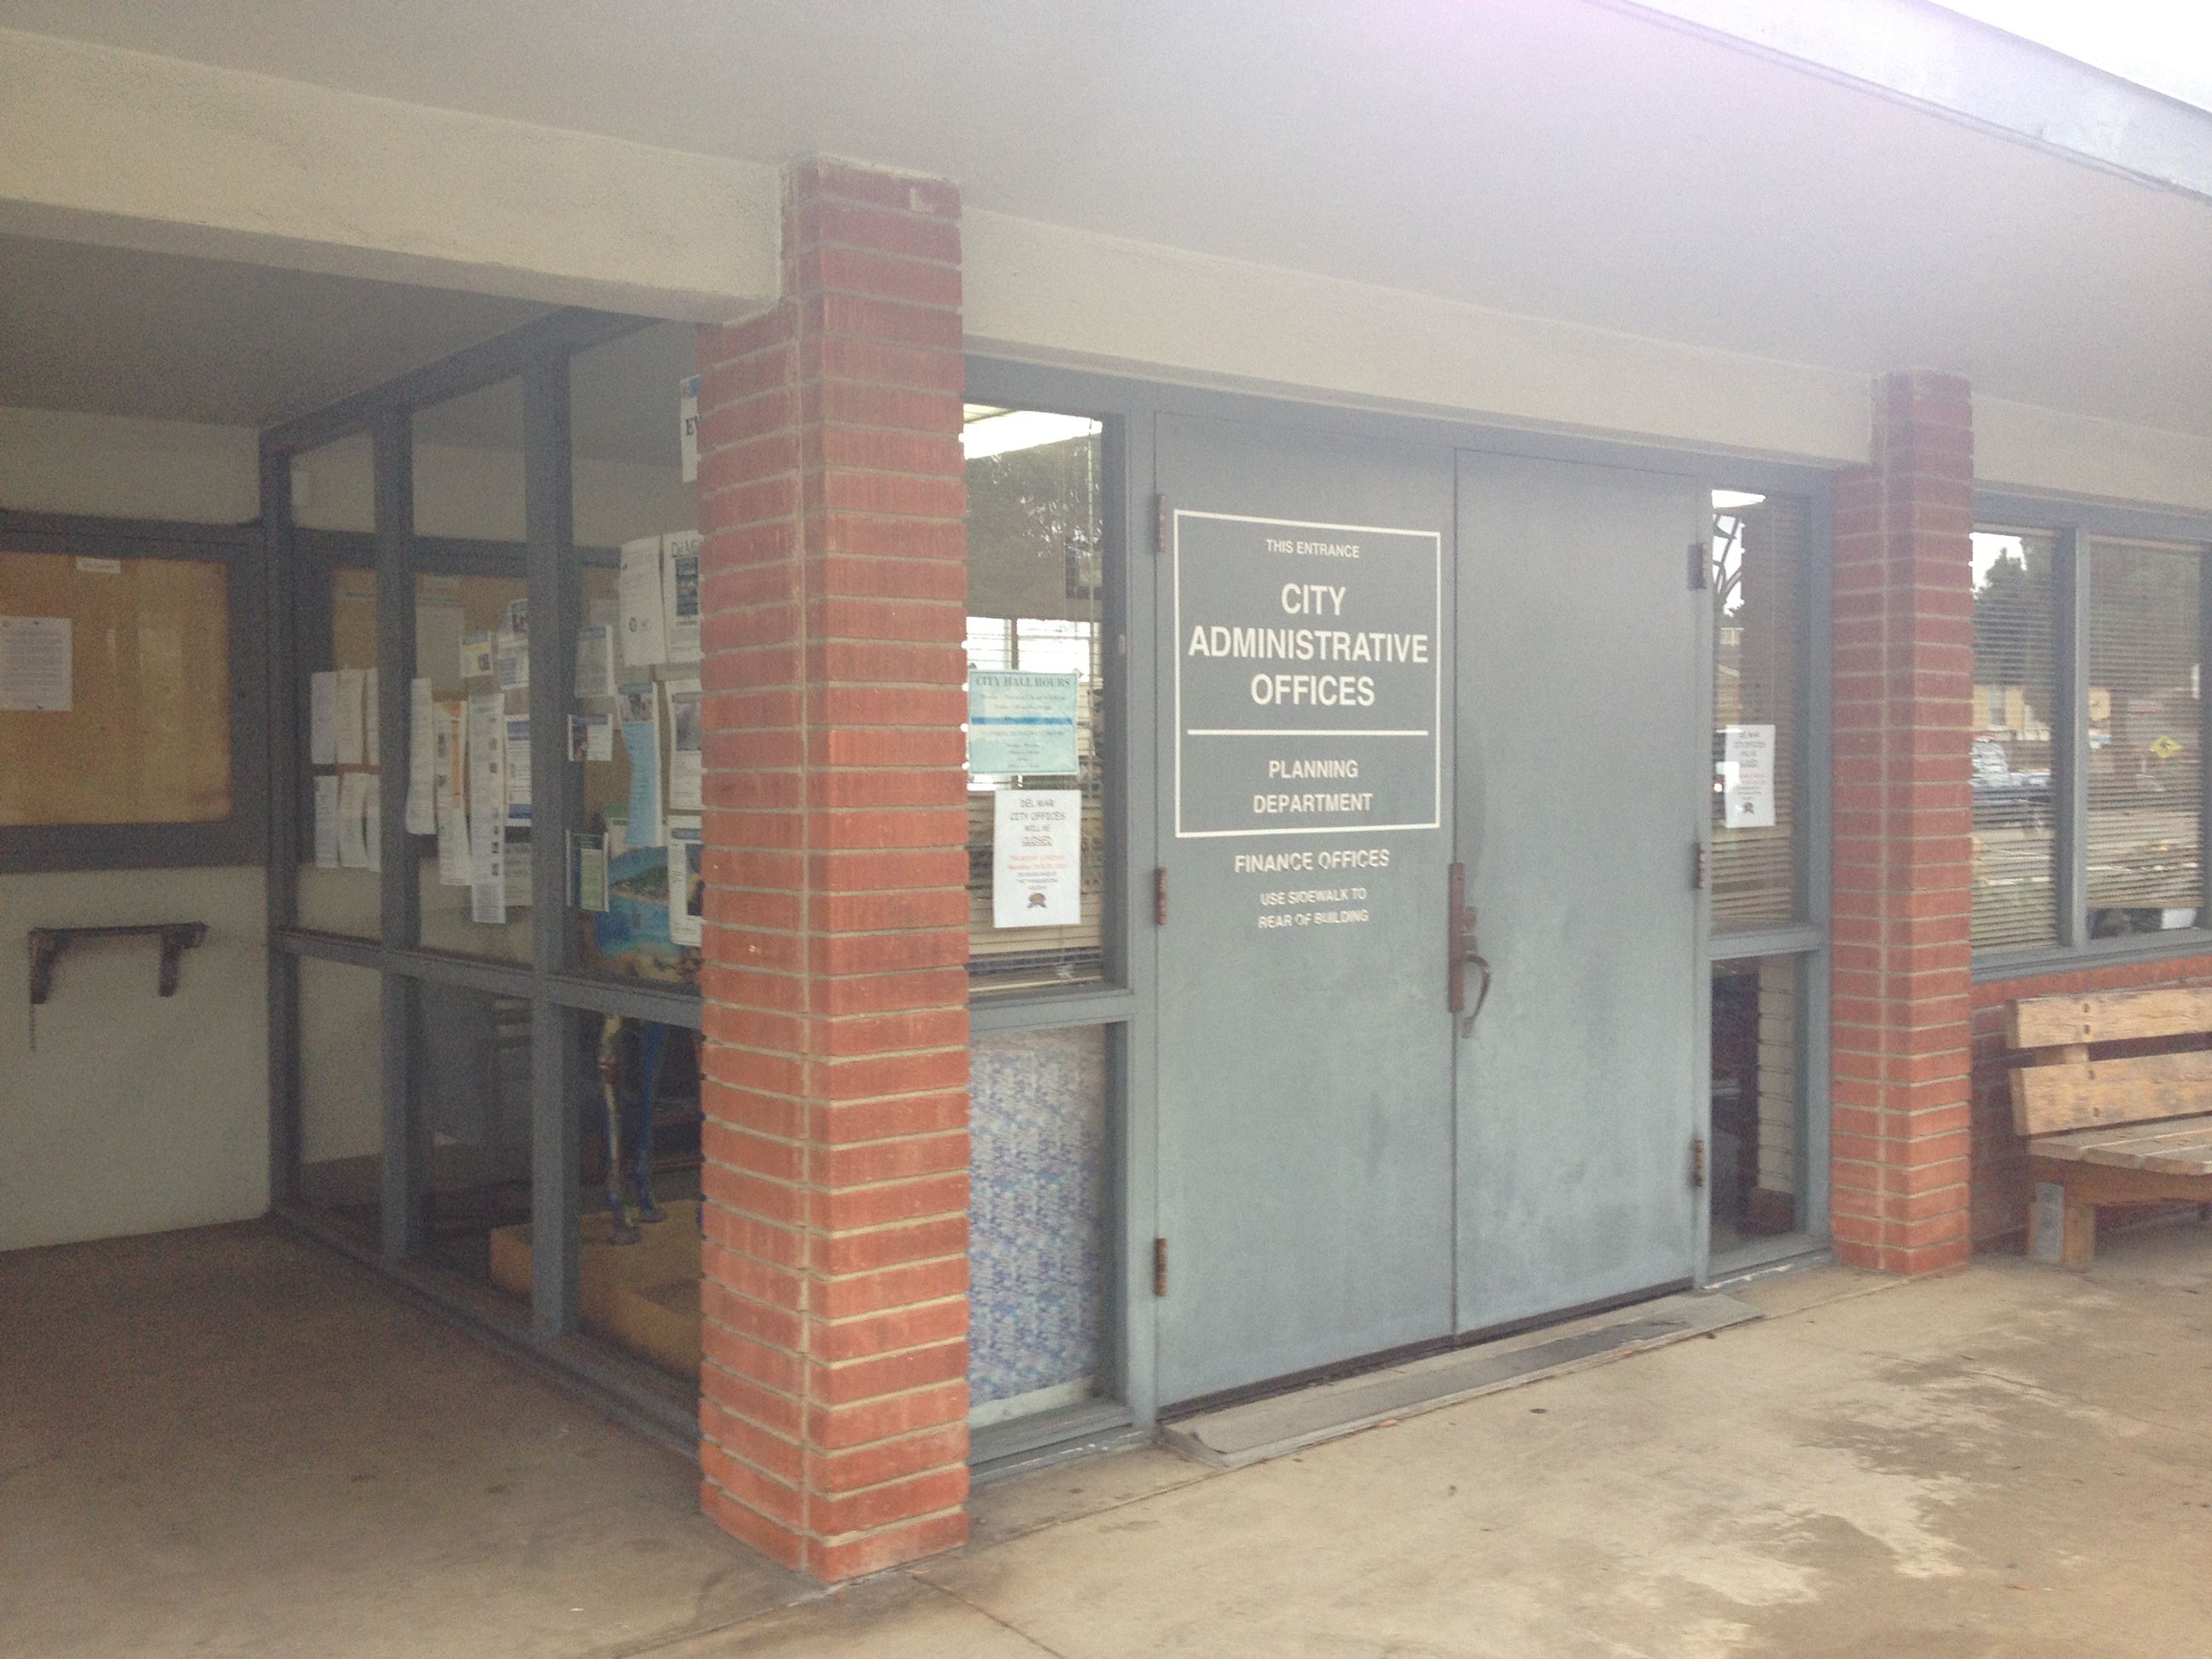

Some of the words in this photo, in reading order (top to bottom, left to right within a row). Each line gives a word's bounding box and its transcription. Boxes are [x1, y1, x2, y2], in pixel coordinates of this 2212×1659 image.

[1266, 538, 1293, 555] THIS
[1297, 540, 1360, 559] ENTRANCE
[1281, 583, 1347, 616] CITY
[1188, 625, 1429, 664] ADMINISTRATIVE
[975, 676, 1001, 687] CITY
[1004, 676, 1033, 687] HALL
[1035, 676, 1070, 687] HOURS
[1251, 673, 1376, 707] OFFICES
[1268, 759, 1359, 780] PLANNING
[1253, 793, 1373, 815] DEPARTMENT
[1009, 812, 1028, 821] CITY
[1030, 812, 1067, 821] OFFICES
[1234, 852, 1314, 874] FINANCE
[1318, 848, 1391, 869] OFFICES
[1260, 892, 1286, 906] USE
[1287, 889, 1348, 904] SIDEWALK
[1351, 887, 1368, 900] TO
[1257, 914, 1292, 929] REAR
[1294, 912, 1312, 926] OF
[1314, 909, 1370, 926] BUILDING
